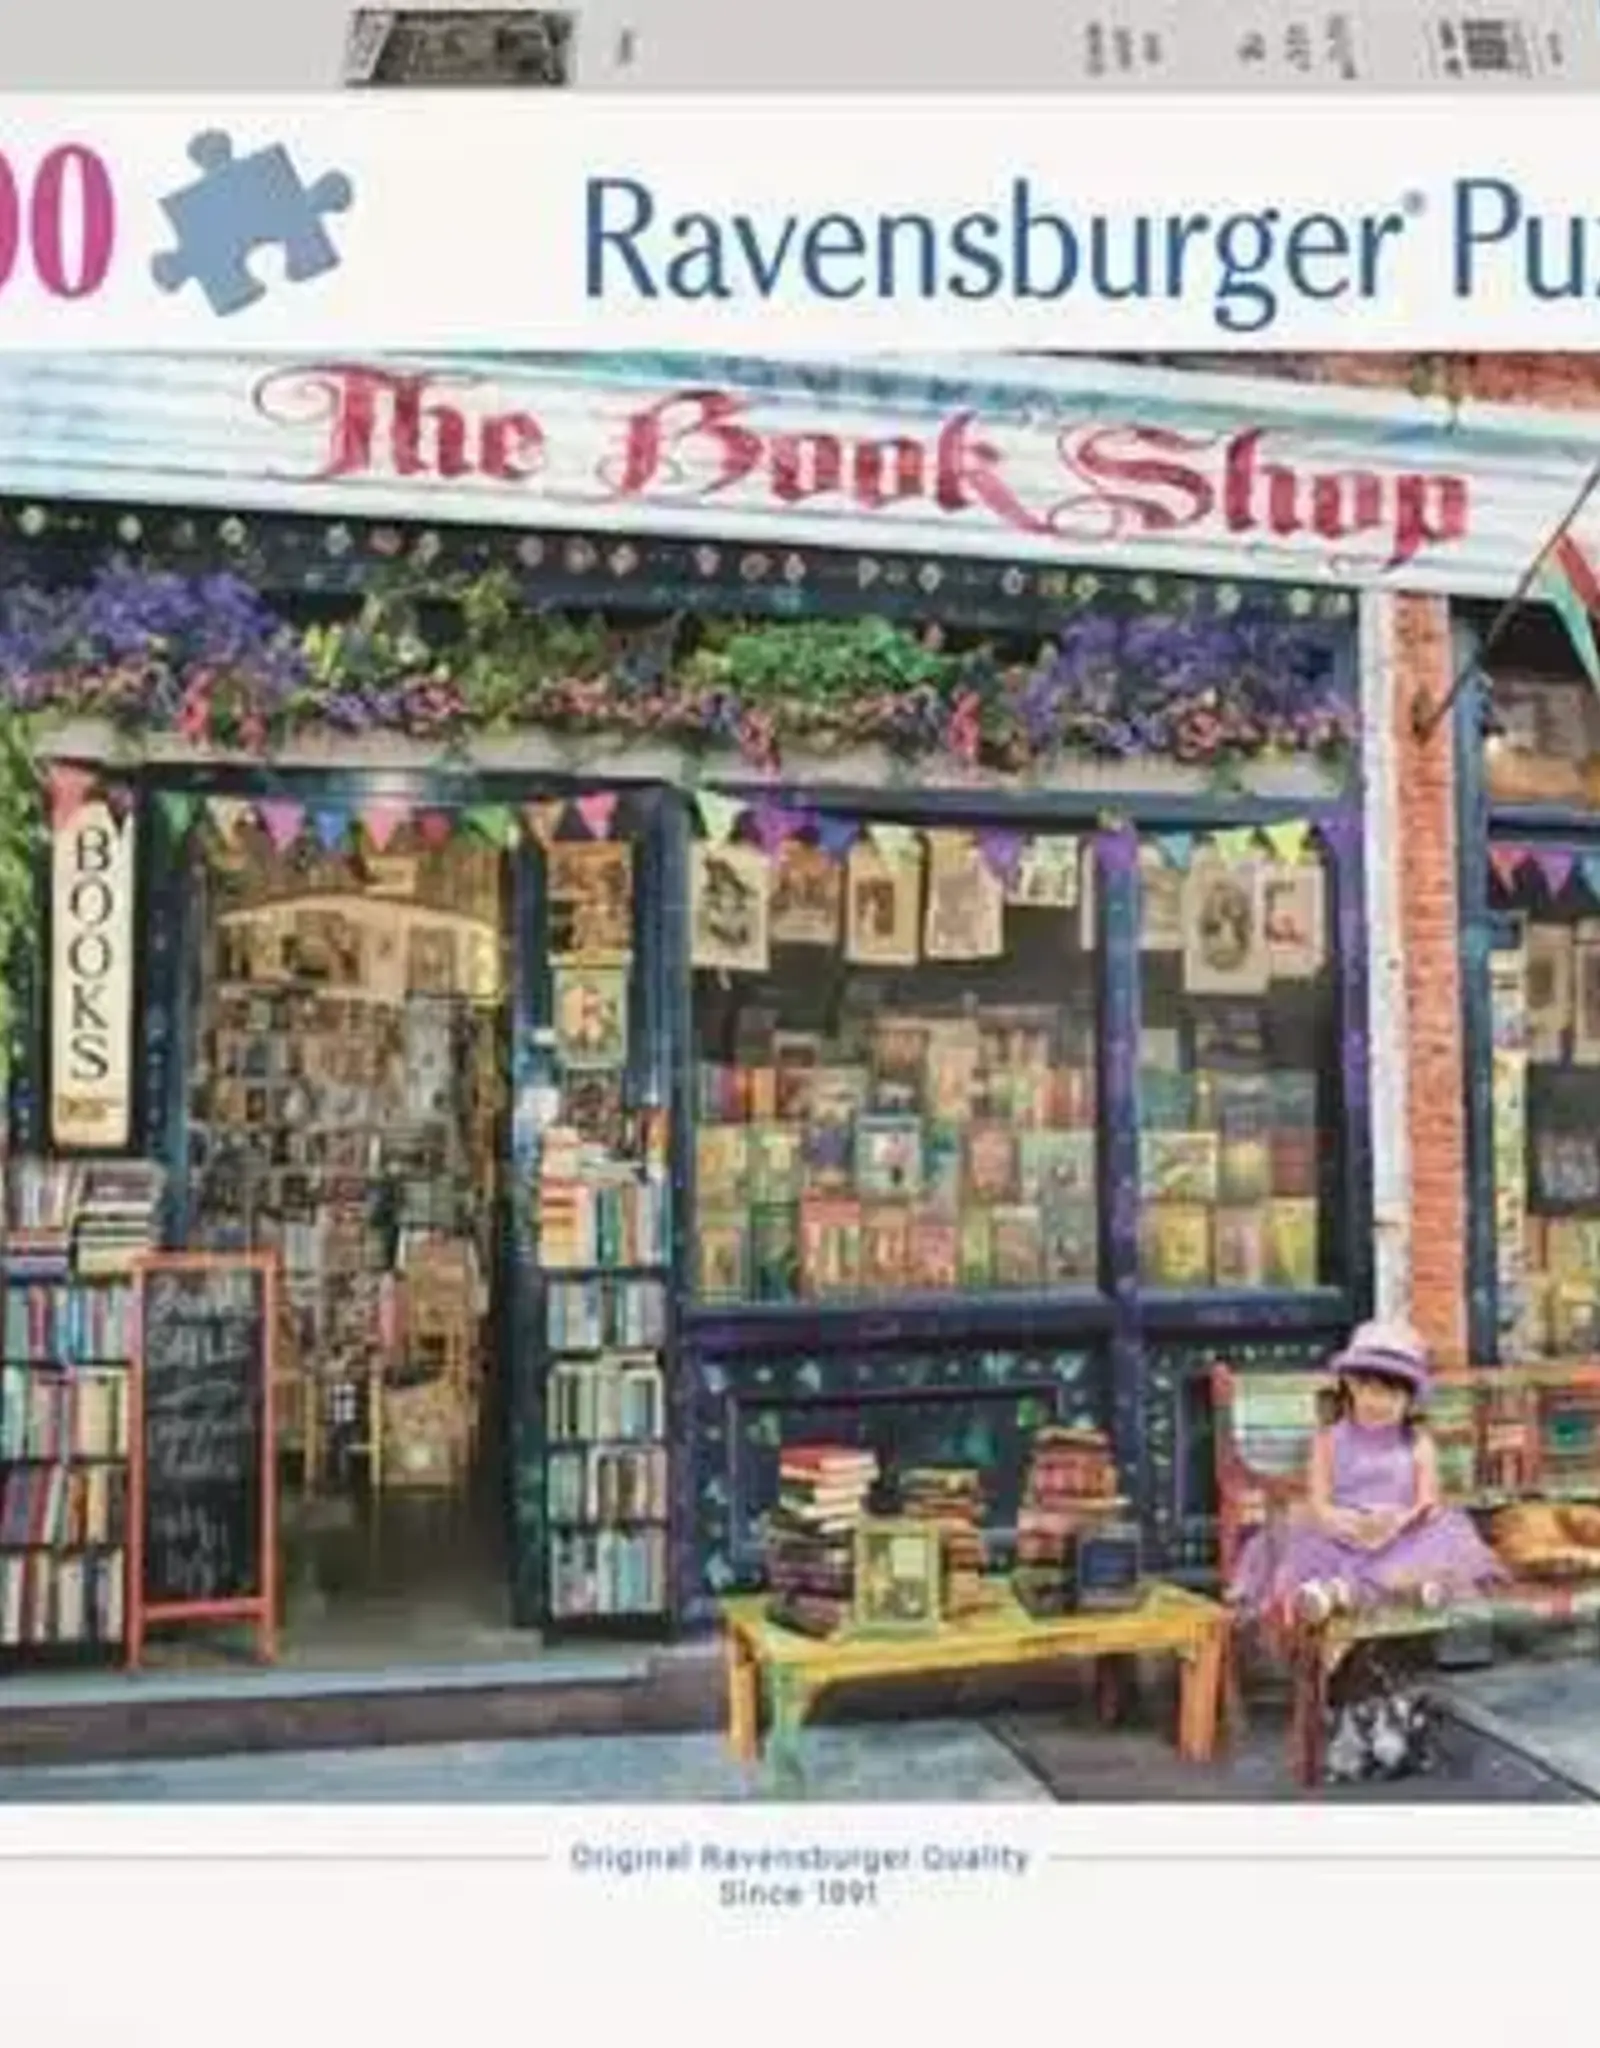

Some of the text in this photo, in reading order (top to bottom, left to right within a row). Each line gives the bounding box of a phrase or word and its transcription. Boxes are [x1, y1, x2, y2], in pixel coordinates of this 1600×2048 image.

[0, 143, 117, 299] 0
[583, 176, 1600, 331] Ravensburger Pu
[253, 363, 547, 485] The
[595, 388, 1057, 535] Book
[1052, 423, 1470, 573] Shop
[68, 825, 115, 1081] BOOKS
[570, 1842, 1029, 1876] Original Ravensburger Quality
[720, 1878, 801, 1906] Since
